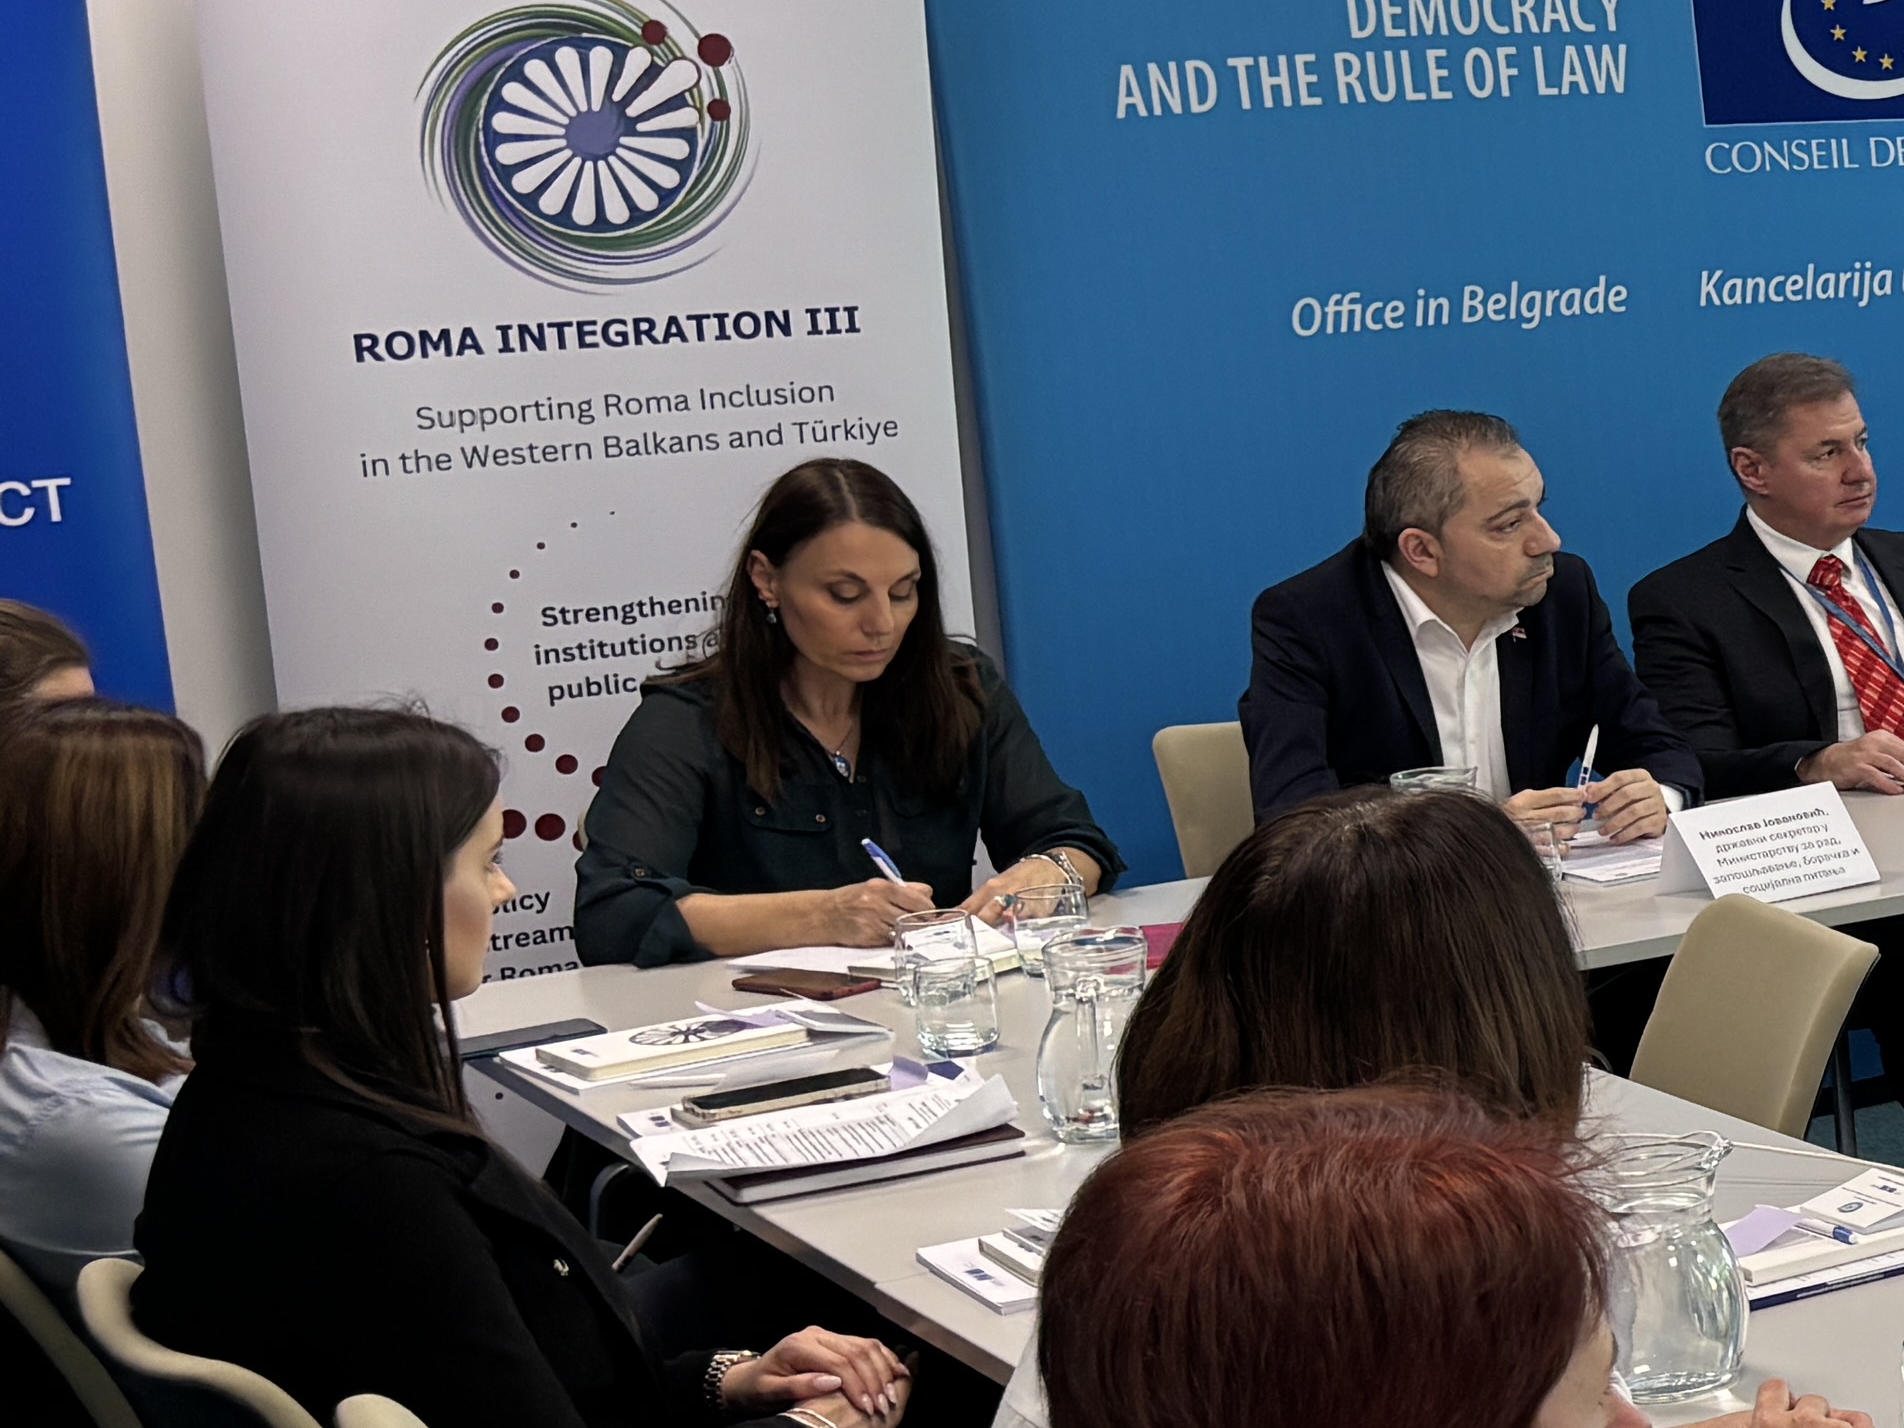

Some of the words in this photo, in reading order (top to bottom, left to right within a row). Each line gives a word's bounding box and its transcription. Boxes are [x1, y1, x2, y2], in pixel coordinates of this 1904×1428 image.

[1117, 60, 1217, 118] AND
[1227, 54, 1322, 109] THE
[1334, 49, 1452, 103] RULE
[1465, 47, 1518, 98] OF
[1534, 44, 1626, 95] LAW
[1706, 139, 1859, 173] CONSEIL
[1293, 292, 1404, 336] Office
[1416, 289, 1449, 326] in
[1463, 276, 1627, 329] Belgrade
[1700, 262, 1892, 307] Kancelarija
[354, 327, 484, 362] ROMA
[496, 310, 791, 353] INTEGRATION
[805, 306, 860, 335] III
[417, 397, 595, 433] Supporting
[604, 394, 690, 417] Roma
[700, 382, 834, 410] Inclusion
[360, 454, 389, 477] in
[399, 449, 451, 474] the
[461, 443, 592, 468] Western
[604, 432, 719, 458] Balkans
[729, 423, 783, 448] and
[792, 417, 897, 445] Türkiye
[534, 633, 697, 666] institutions
[548, 673, 638, 707] public
